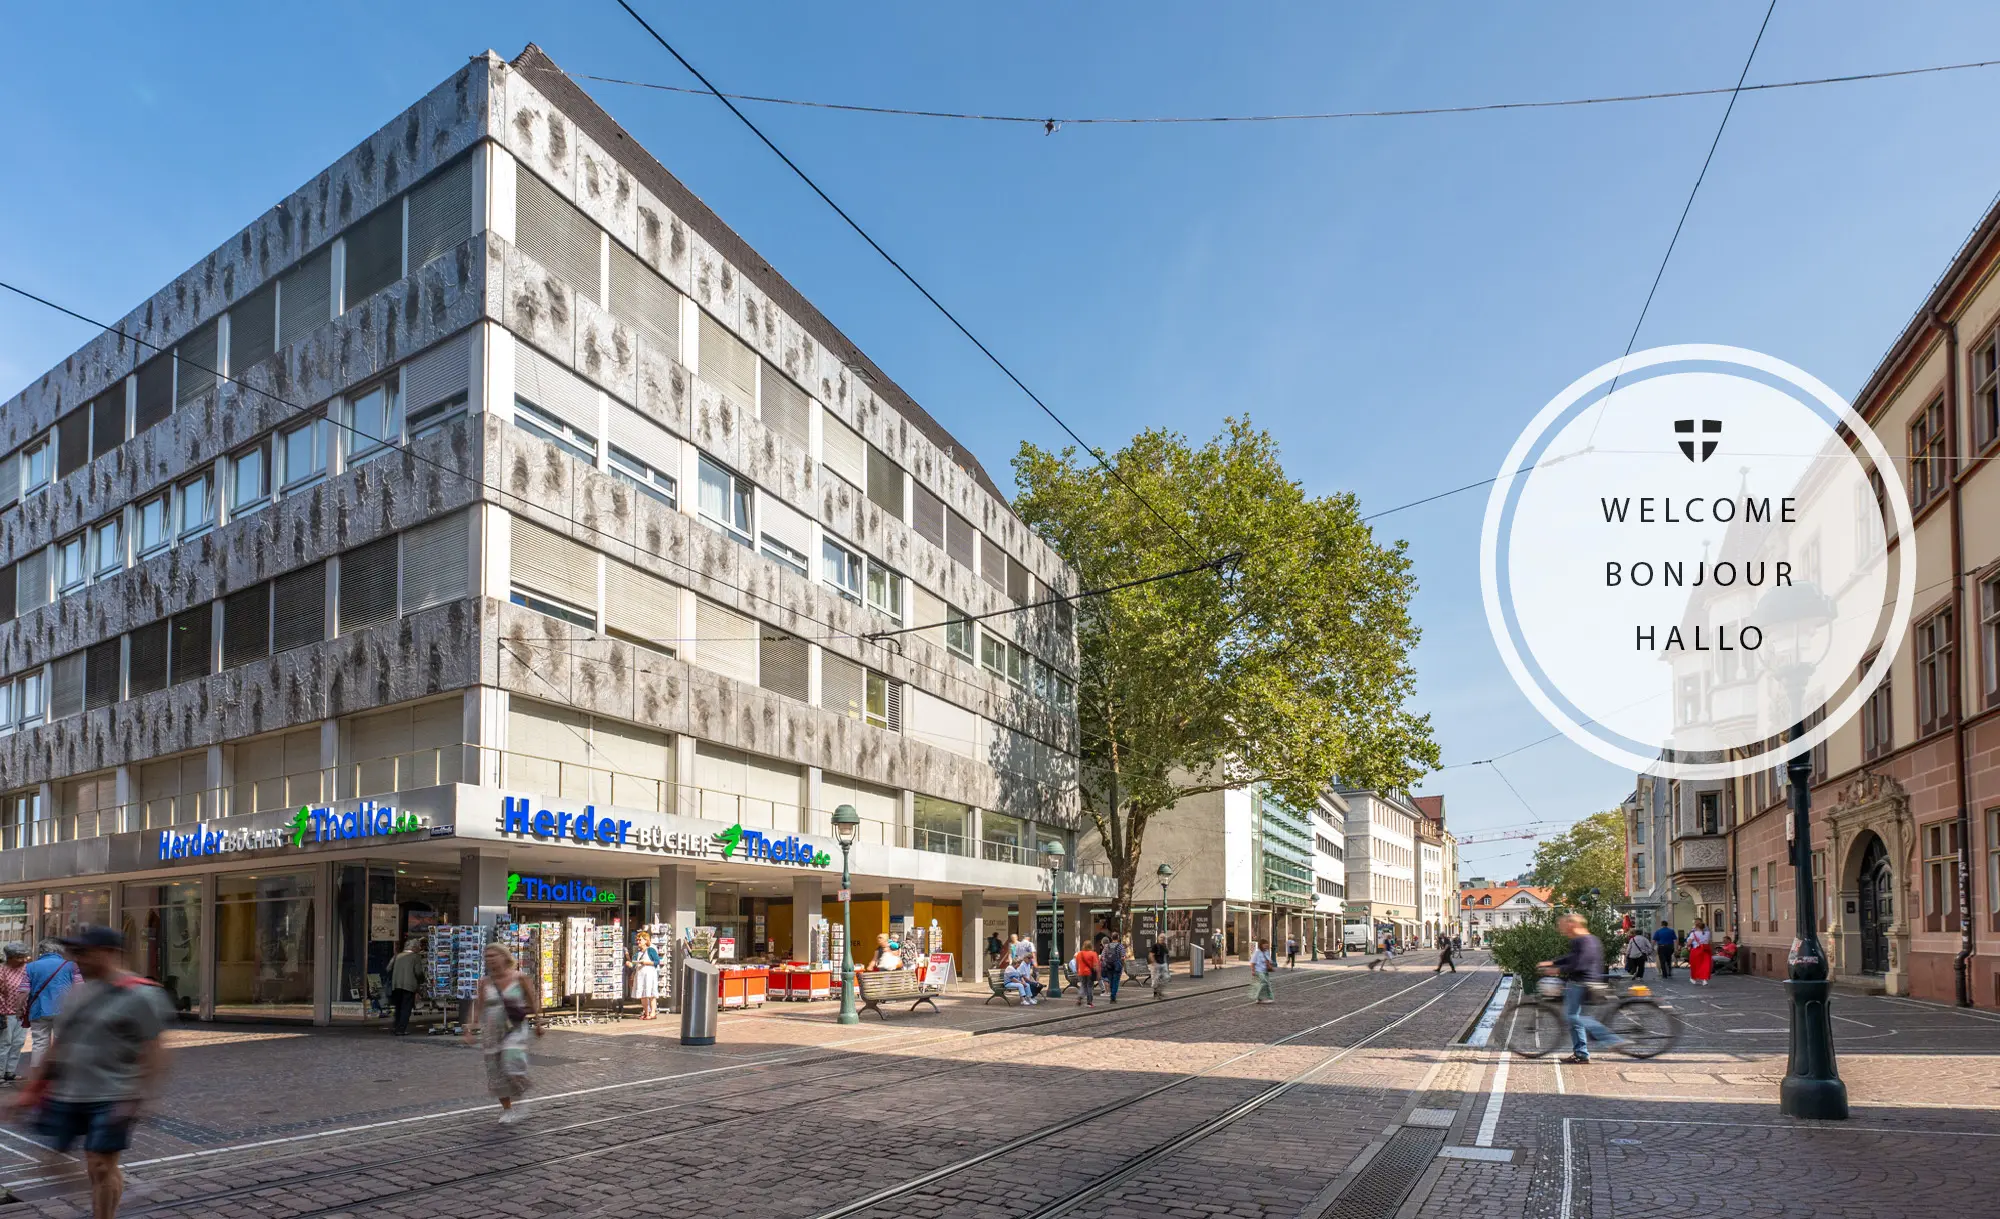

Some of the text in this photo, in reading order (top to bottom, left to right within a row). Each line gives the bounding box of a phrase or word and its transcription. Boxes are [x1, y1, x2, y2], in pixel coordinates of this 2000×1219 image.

[160, 824, 225, 860] Herder
[227, 827, 284, 852] BÜCHER
[503, 796, 632, 845] Herder
[639, 825, 711, 853] BÜCHER
